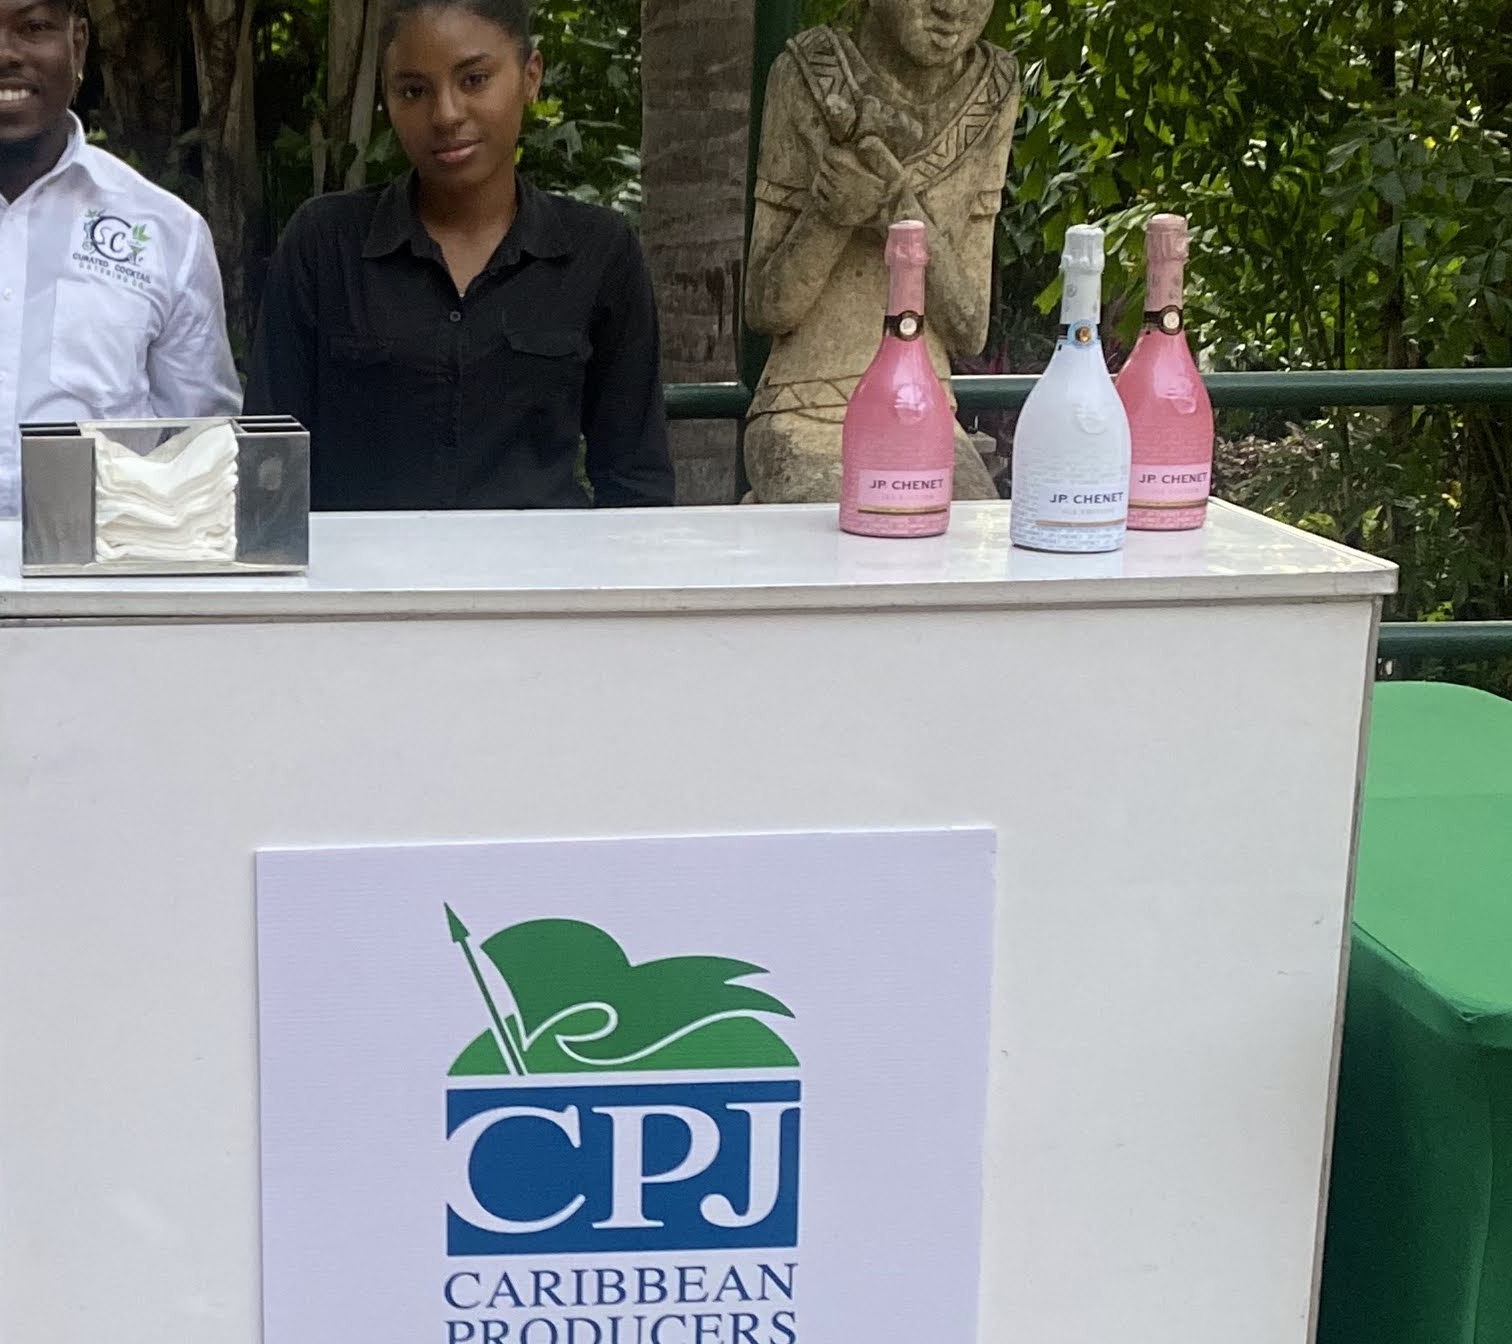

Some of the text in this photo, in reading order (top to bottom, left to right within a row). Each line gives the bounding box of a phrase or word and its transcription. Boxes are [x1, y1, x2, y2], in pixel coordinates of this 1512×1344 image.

[72, 253, 152, 284] CURATED COCKTAIL
[891, 478, 944, 491] CHENET
[1161, 472, 1208, 484] CHENET
[1073, 492, 1123, 504] CHENET
[445, 1101, 800, 1233] CPJ
[445, 1264, 797, 1308] CARIBBEAN
